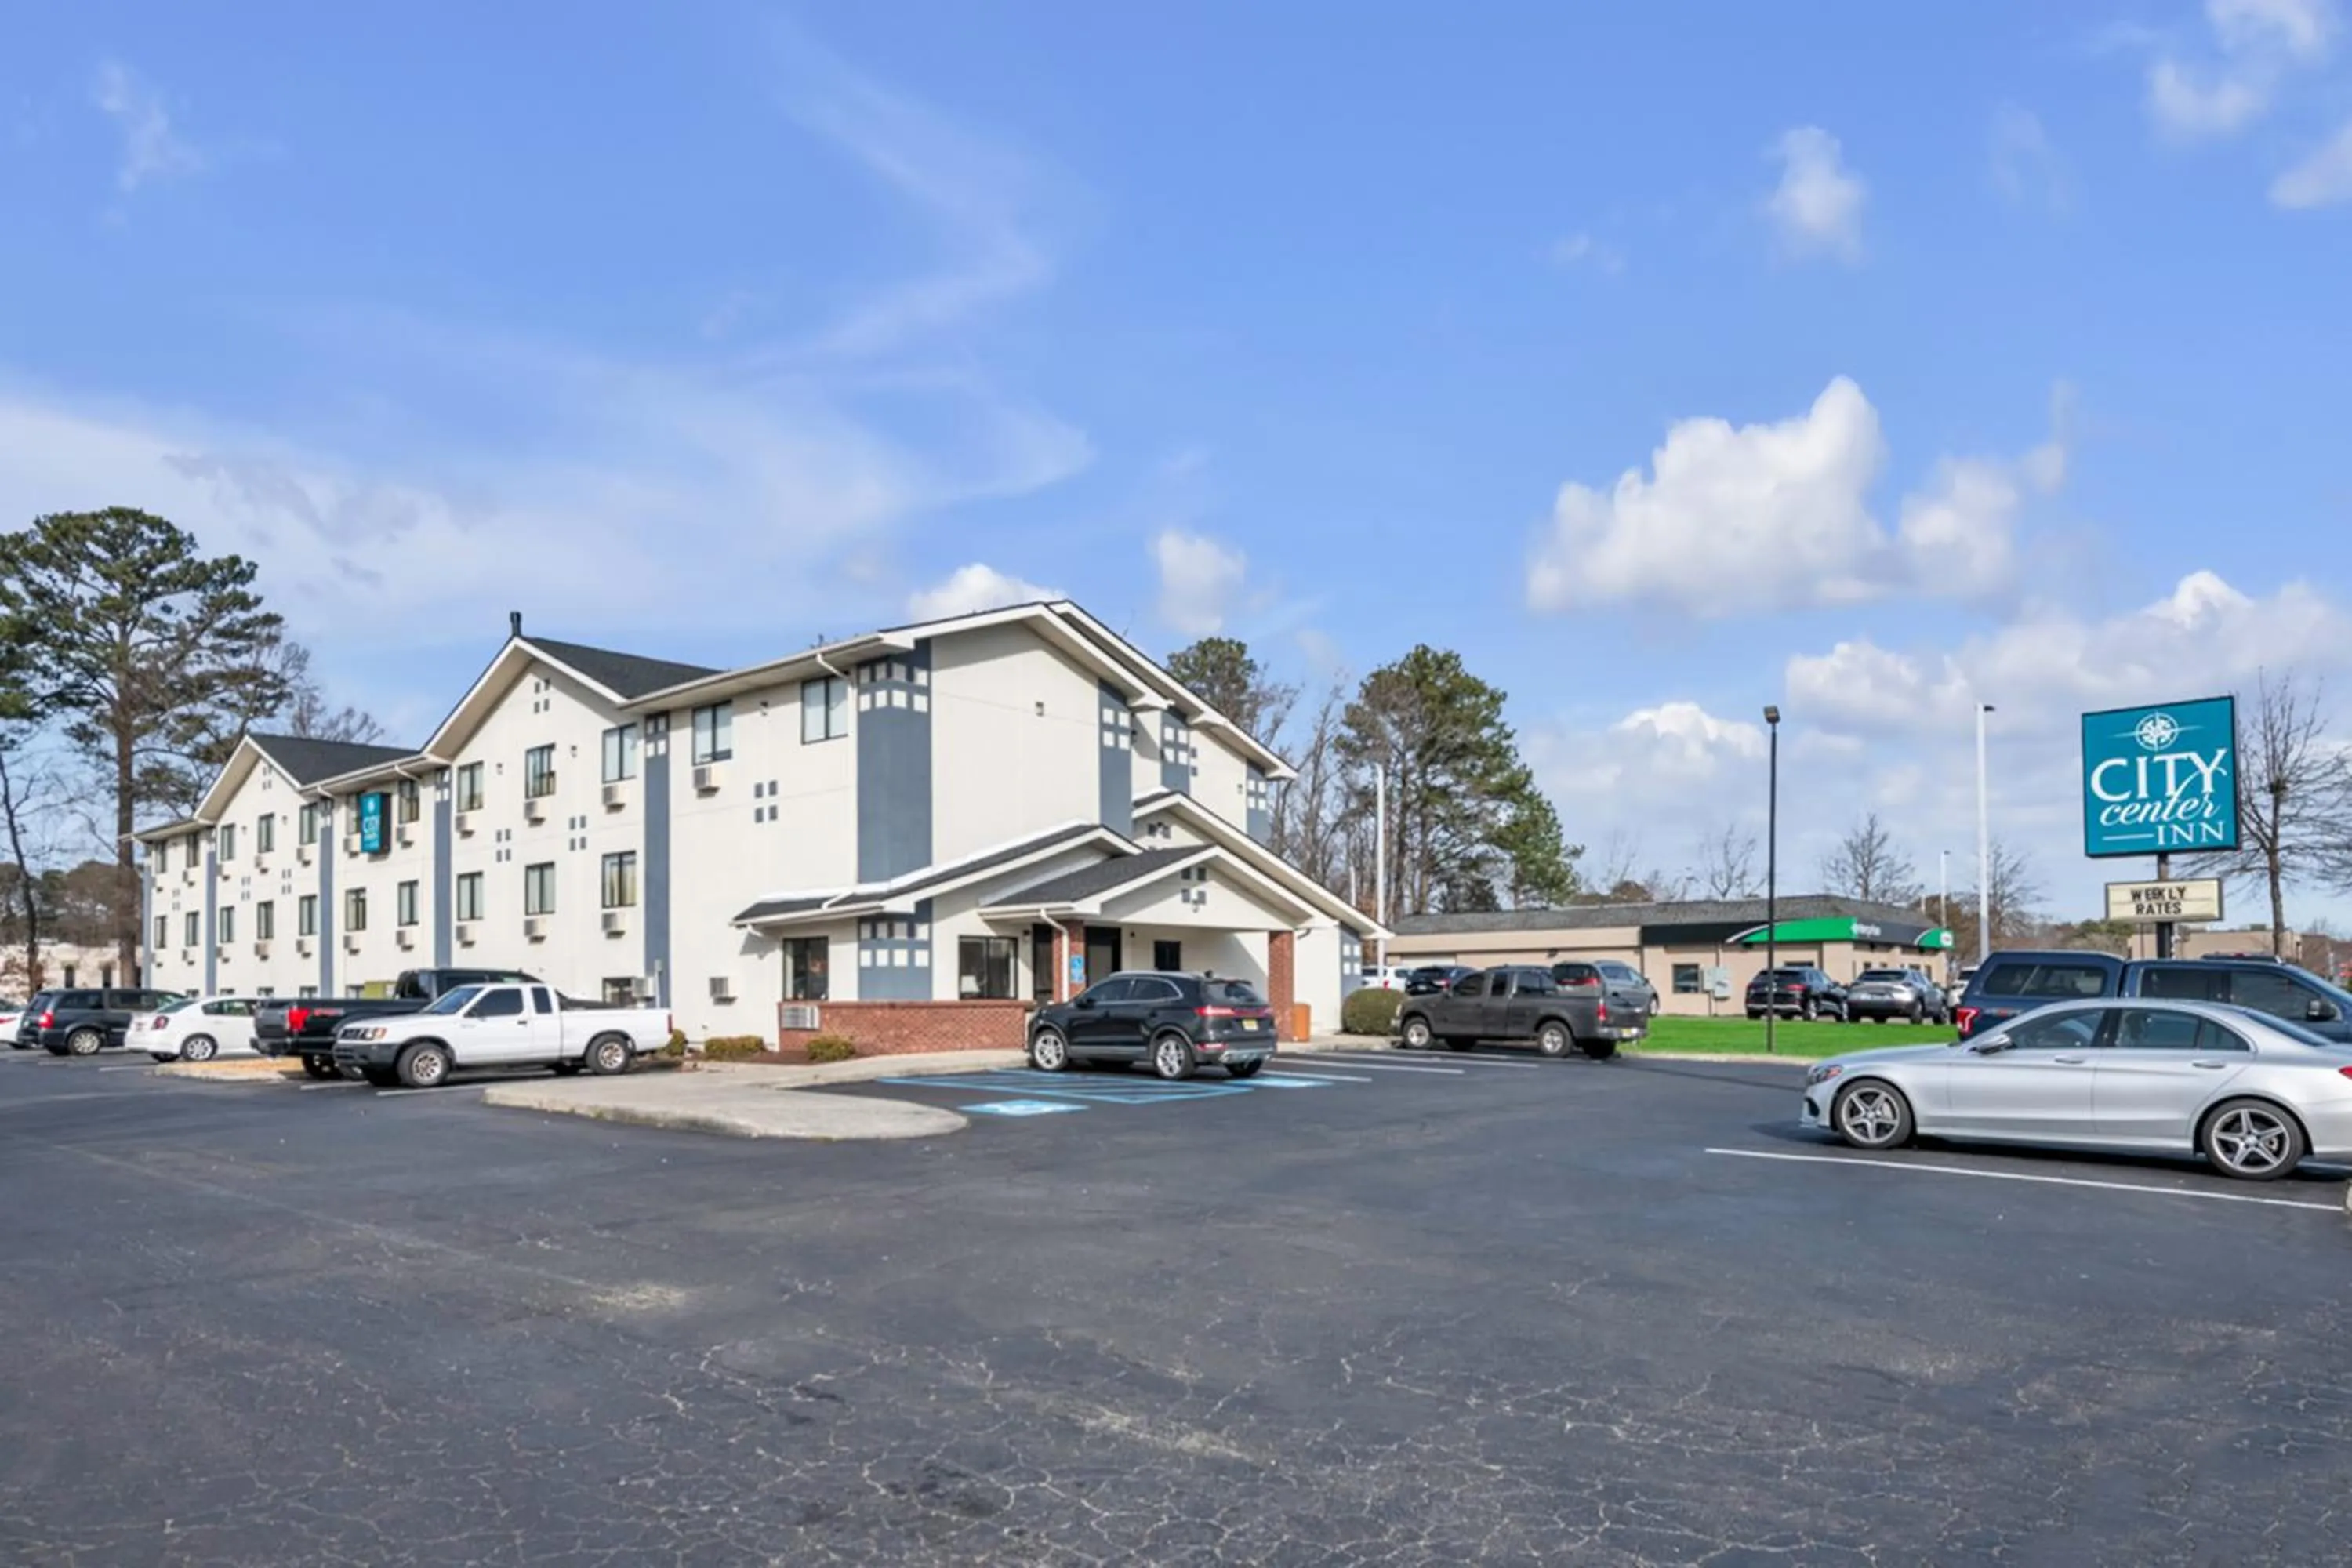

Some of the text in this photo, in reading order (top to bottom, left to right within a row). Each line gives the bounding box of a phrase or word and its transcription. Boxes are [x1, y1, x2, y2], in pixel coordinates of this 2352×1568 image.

[2091, 748, 2227, 802] CITY
[2100, 768, 2227, 826] center
[2158, 821, 2225, 846] INN
[2131, 886, 2186, 902] WEEKLY
[2136, 902, 2182, 915] RATES
